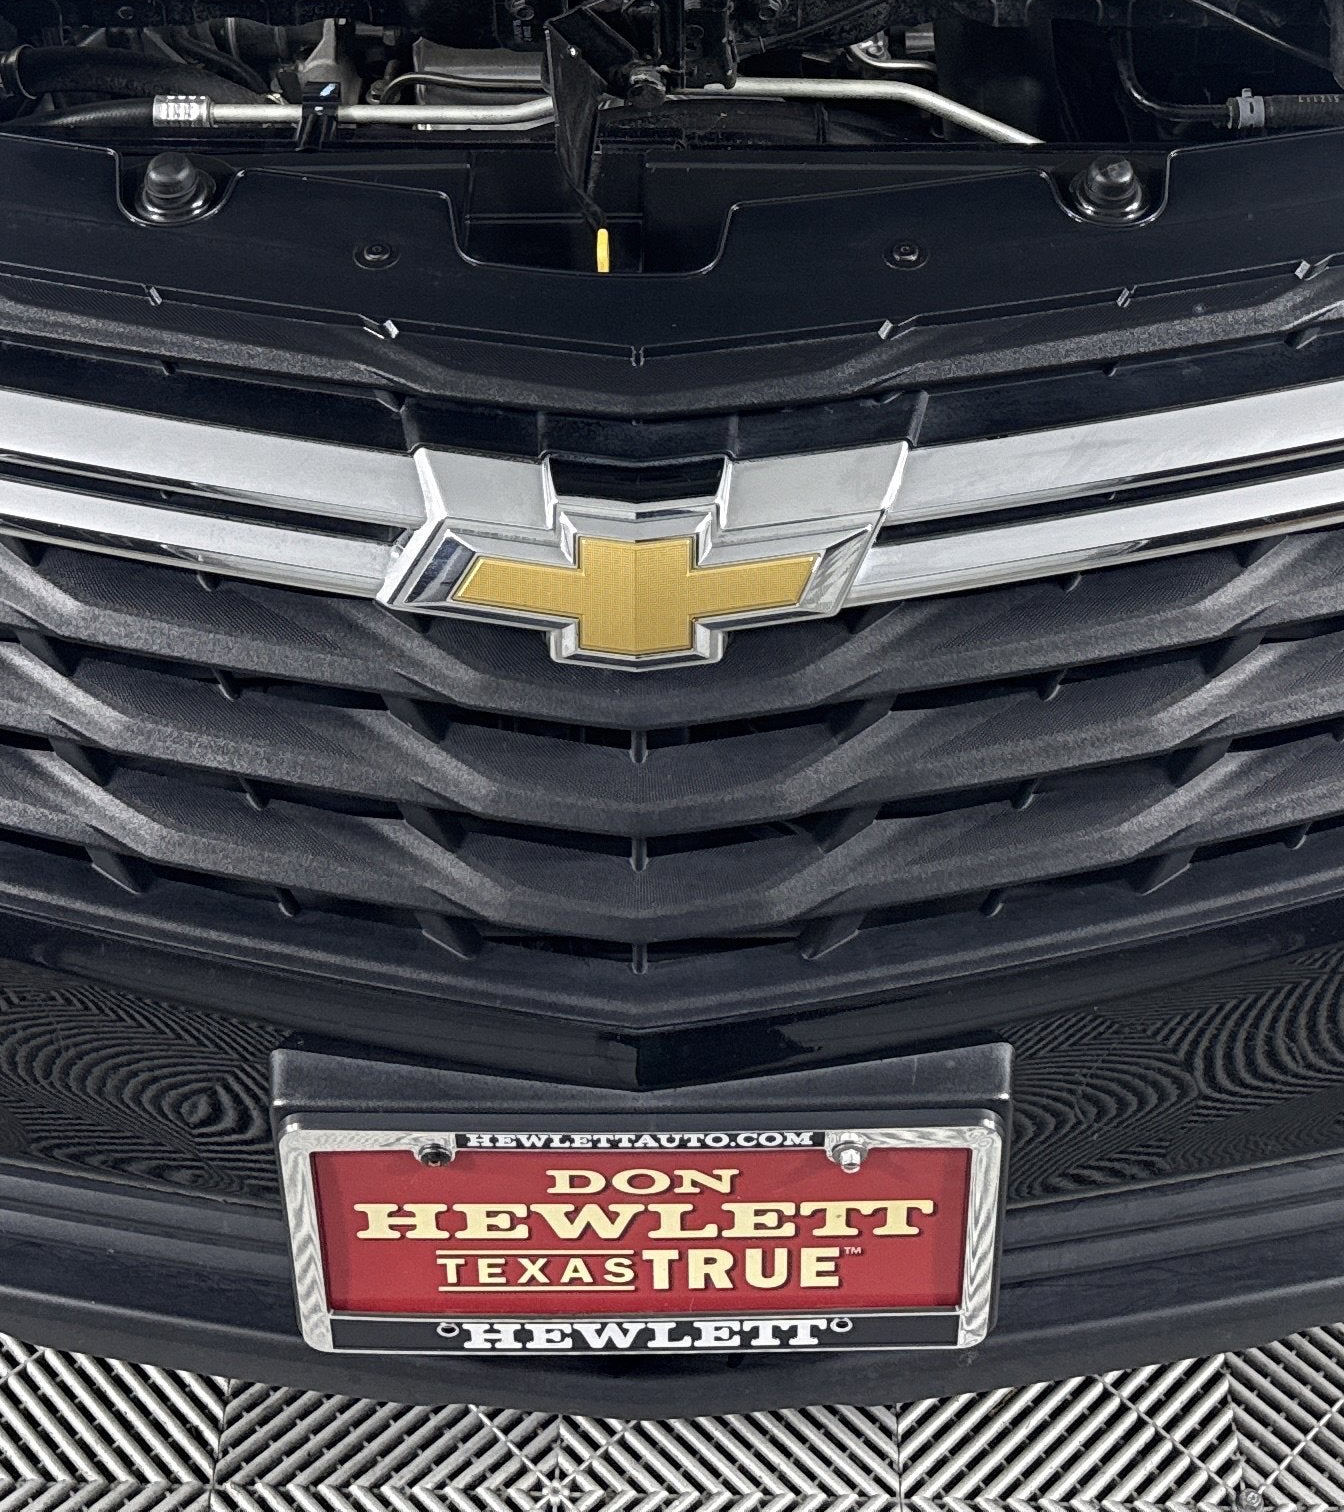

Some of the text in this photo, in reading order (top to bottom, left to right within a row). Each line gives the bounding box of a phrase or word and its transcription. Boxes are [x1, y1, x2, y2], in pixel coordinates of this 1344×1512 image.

[465, 1131, 813, 1148] HEWLETTAUTO.COM
[545, 1168, 739, 1195] DON
[353, 1199, 934, 1240] HEWLETT
[462, 1319, 827, 1350] HEWLETT
